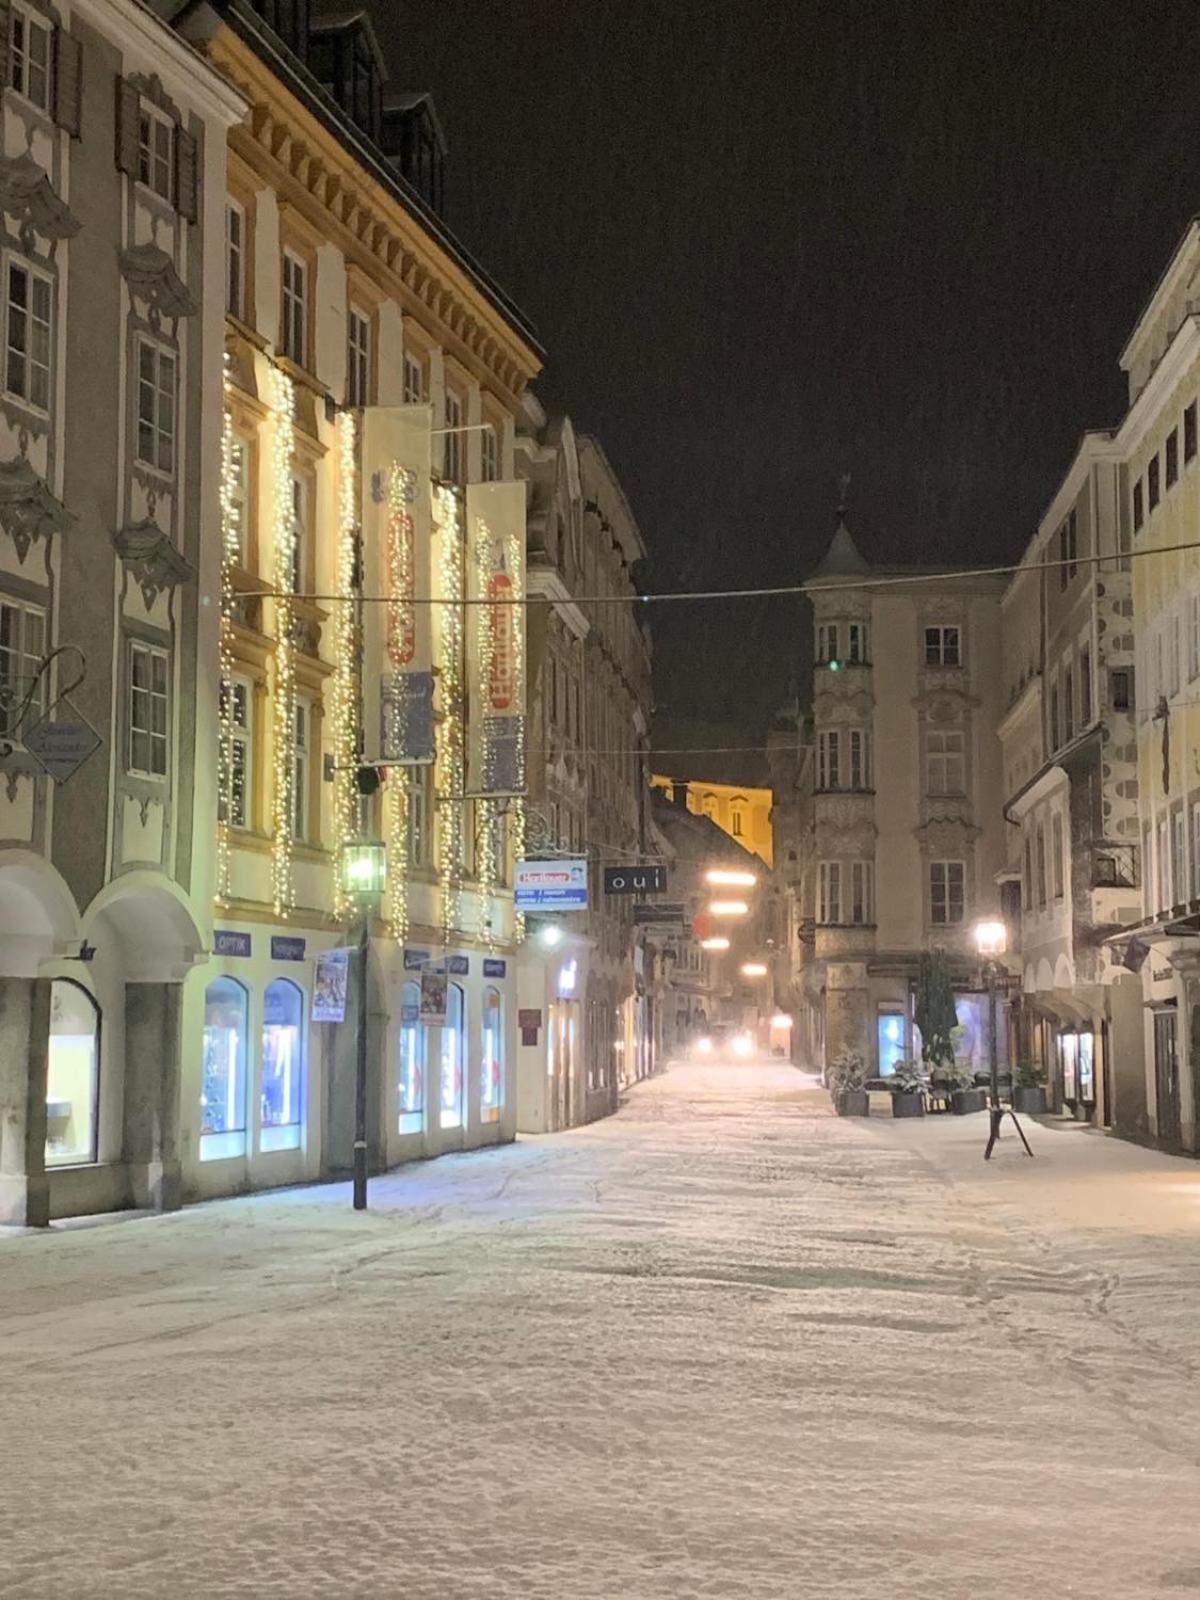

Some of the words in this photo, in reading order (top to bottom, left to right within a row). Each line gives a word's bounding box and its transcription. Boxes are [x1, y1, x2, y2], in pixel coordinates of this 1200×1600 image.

[492, 585, 512, 698] Hartlauer
[612, 868, 659, 888] oui
[218, 935, 245, 951] OPTIK
